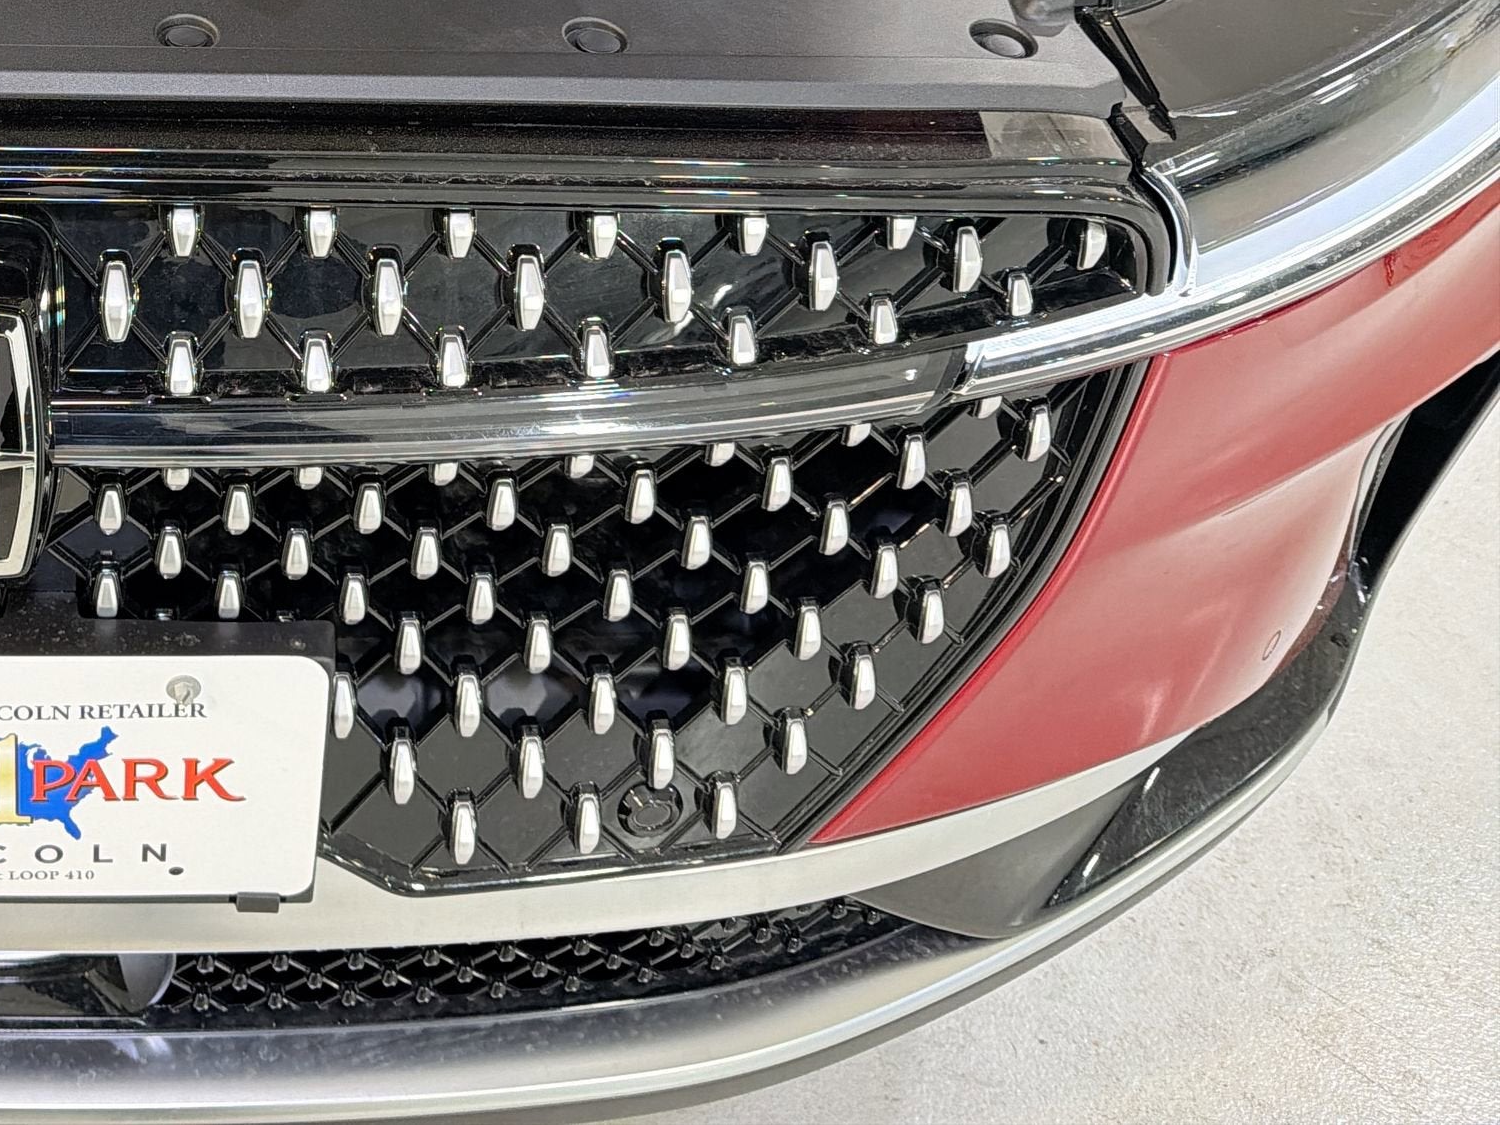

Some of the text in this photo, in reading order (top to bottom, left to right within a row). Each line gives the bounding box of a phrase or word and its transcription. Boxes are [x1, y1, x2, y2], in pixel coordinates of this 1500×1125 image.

[78, 702, 207, 719] RETAILER
[30, 757, 246, 803] PARK
[9, 869, 60, 881] LOOP
[64, 869, 95, 881] 410
